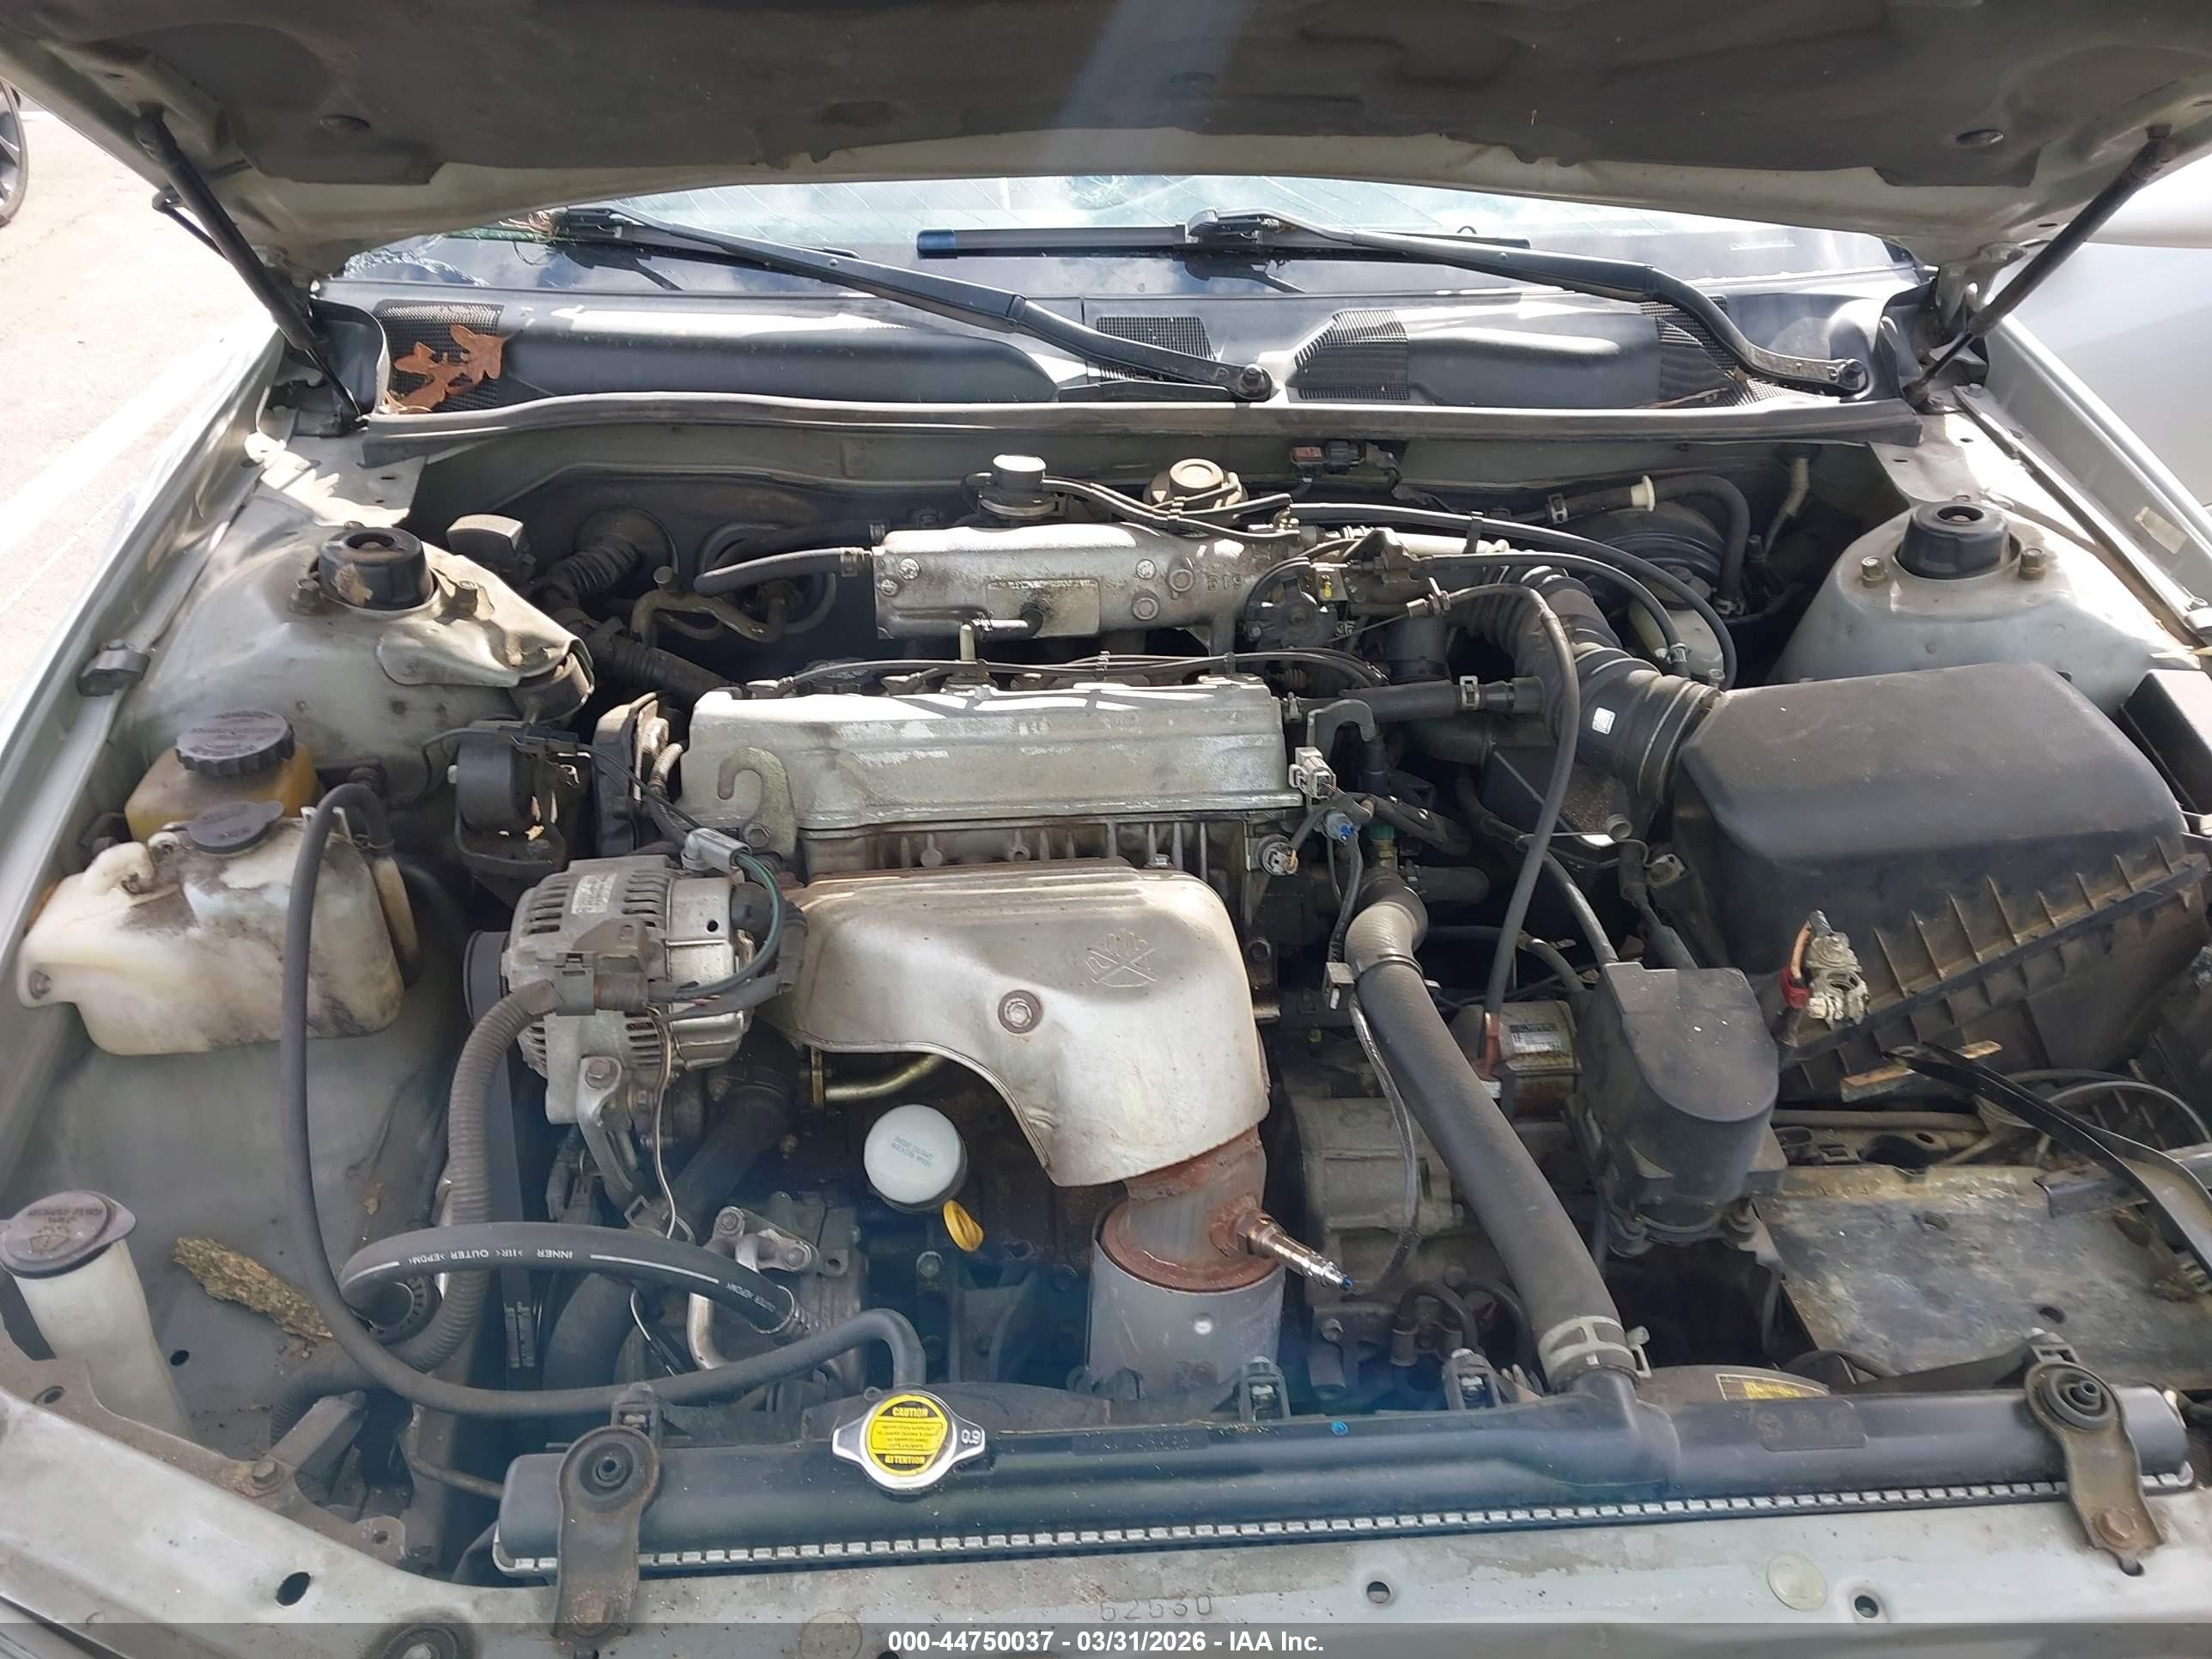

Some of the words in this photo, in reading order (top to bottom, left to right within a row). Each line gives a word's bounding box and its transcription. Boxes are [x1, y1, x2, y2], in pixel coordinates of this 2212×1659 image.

[450, 1249, 489, 1260] OUTER
[537, 1249, 573, 1260] INNER
[891, 1406, 929, 1418] CAUTION
[884, 1455, 926, 1465] ATTENTION
